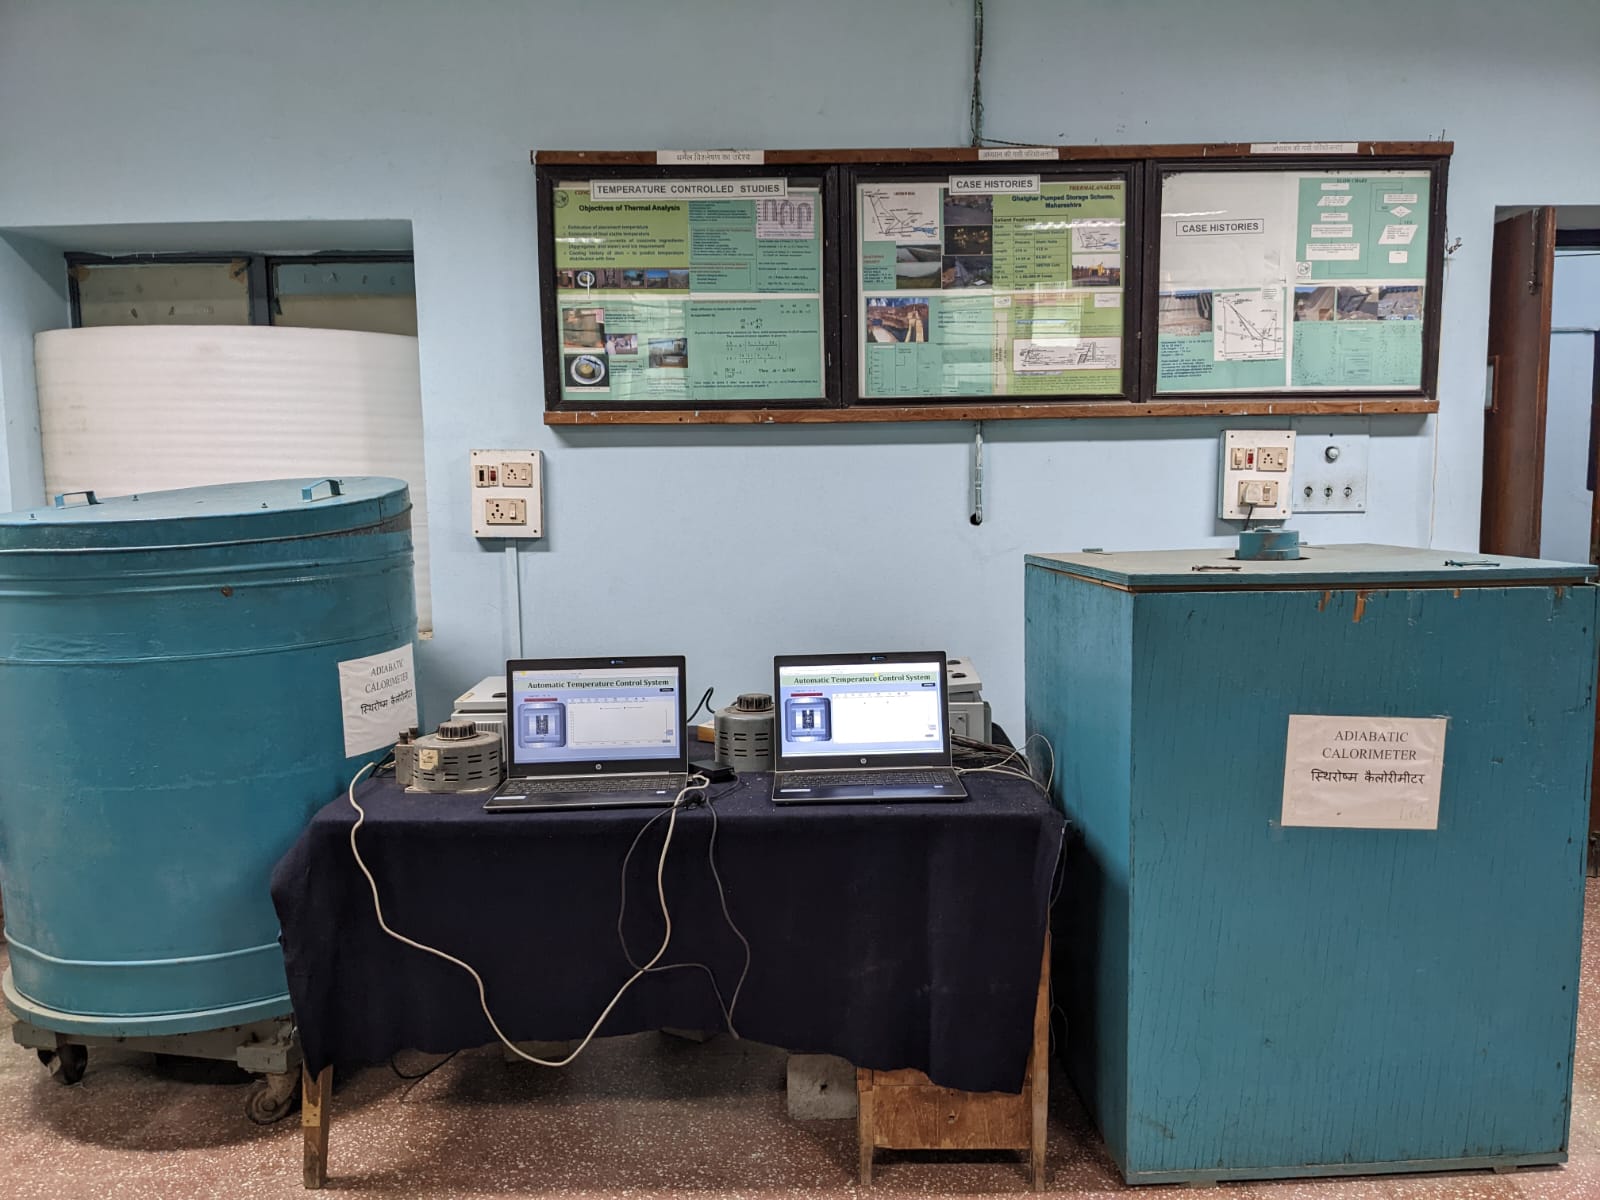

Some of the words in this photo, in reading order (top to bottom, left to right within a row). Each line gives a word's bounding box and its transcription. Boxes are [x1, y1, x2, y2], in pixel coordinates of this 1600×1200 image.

[596, 185, 667, 194] TEMPERATURE
[670, 184, 734, 194] CONTROLLED
[740, 184, 780, 193] STUDIES
[956, 180, 982, 189] CASE
[984, 180, 1033, 188] HISTORIES
[578, 204, 614, 212] Objectives
[652, 204, 681, 212] Analysis
[1182, 224, 1208, 233] CASE
[1210, 222, 1259, 232] HISTORIES
[364, 672, 409, 694] CALORIMETER
[528, 681, 565, 689] Automatic
[566, 680, 614, 690] Temperature
[616, 679, 642, 687] Control
[643, 679, 670, 688] System
[794, 676, 829, 684] Automatic
[830, 676, 876, 684] Temperature
[878, 674, 905, 682] Control
[905, 674, 931, 682] System
[1334, 730, 1409, 743] ADIABATIC
[1322, 747, 1418, 760] CALORIMETER
[1311, 768, 1358, 783] स्थिरोष्म
[1364, 769, 1426, 785] कैलोरीमीटर
